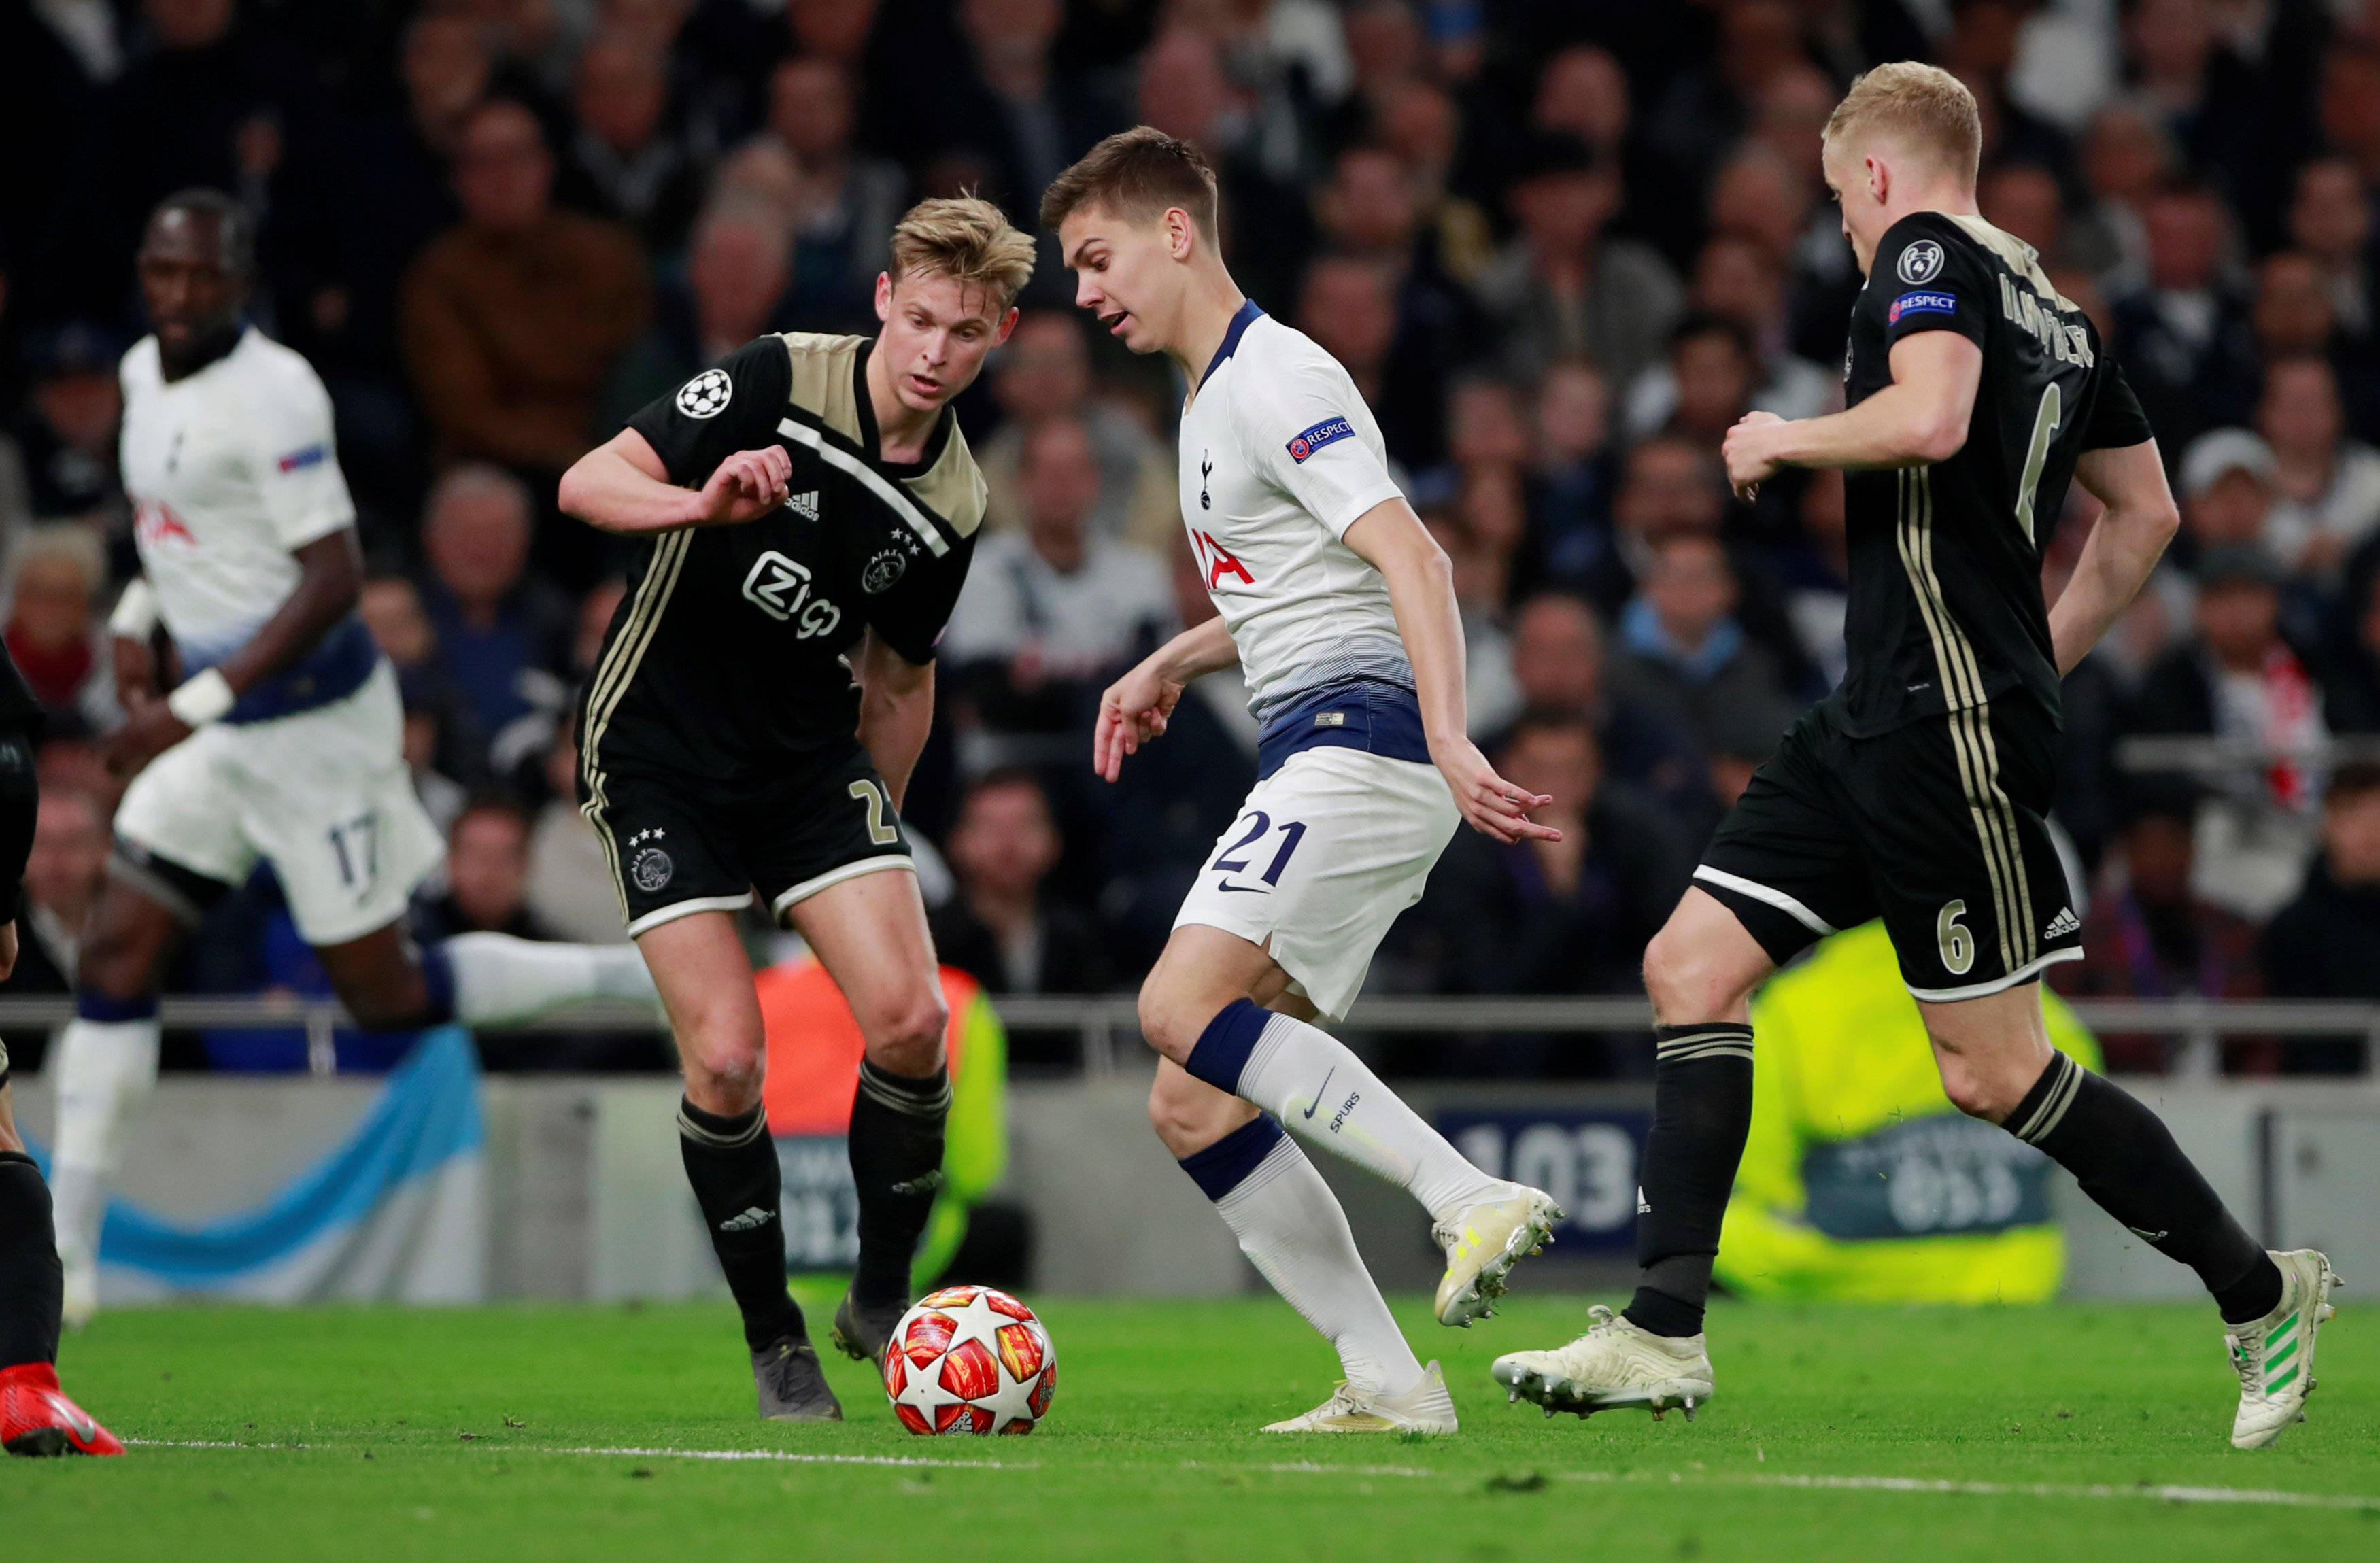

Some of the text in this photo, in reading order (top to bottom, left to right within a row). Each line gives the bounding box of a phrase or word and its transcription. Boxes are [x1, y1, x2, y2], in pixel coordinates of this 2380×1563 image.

[1912, 260, 1926, 272] 4
[1901, 295, 1956, 311] RESPECT
[1306, 422, 1351, 446] RESPECT
[784, 498, 820, 521] adidas
[1191, 528, 1256, 589] IA
[848, 778, 898, 845] 2
[329, 810, 381, 886] 17
[1211, 810, 1308, 888] 21
[1937, 899, 1975, 975] 6
[2043, 919, 2081, 940] adidas
[1330, 1091, 1361, 1134] SPURS
[1457, 1122, 1637, 1232] 103
[945, 1410, 972, 1435] adida
